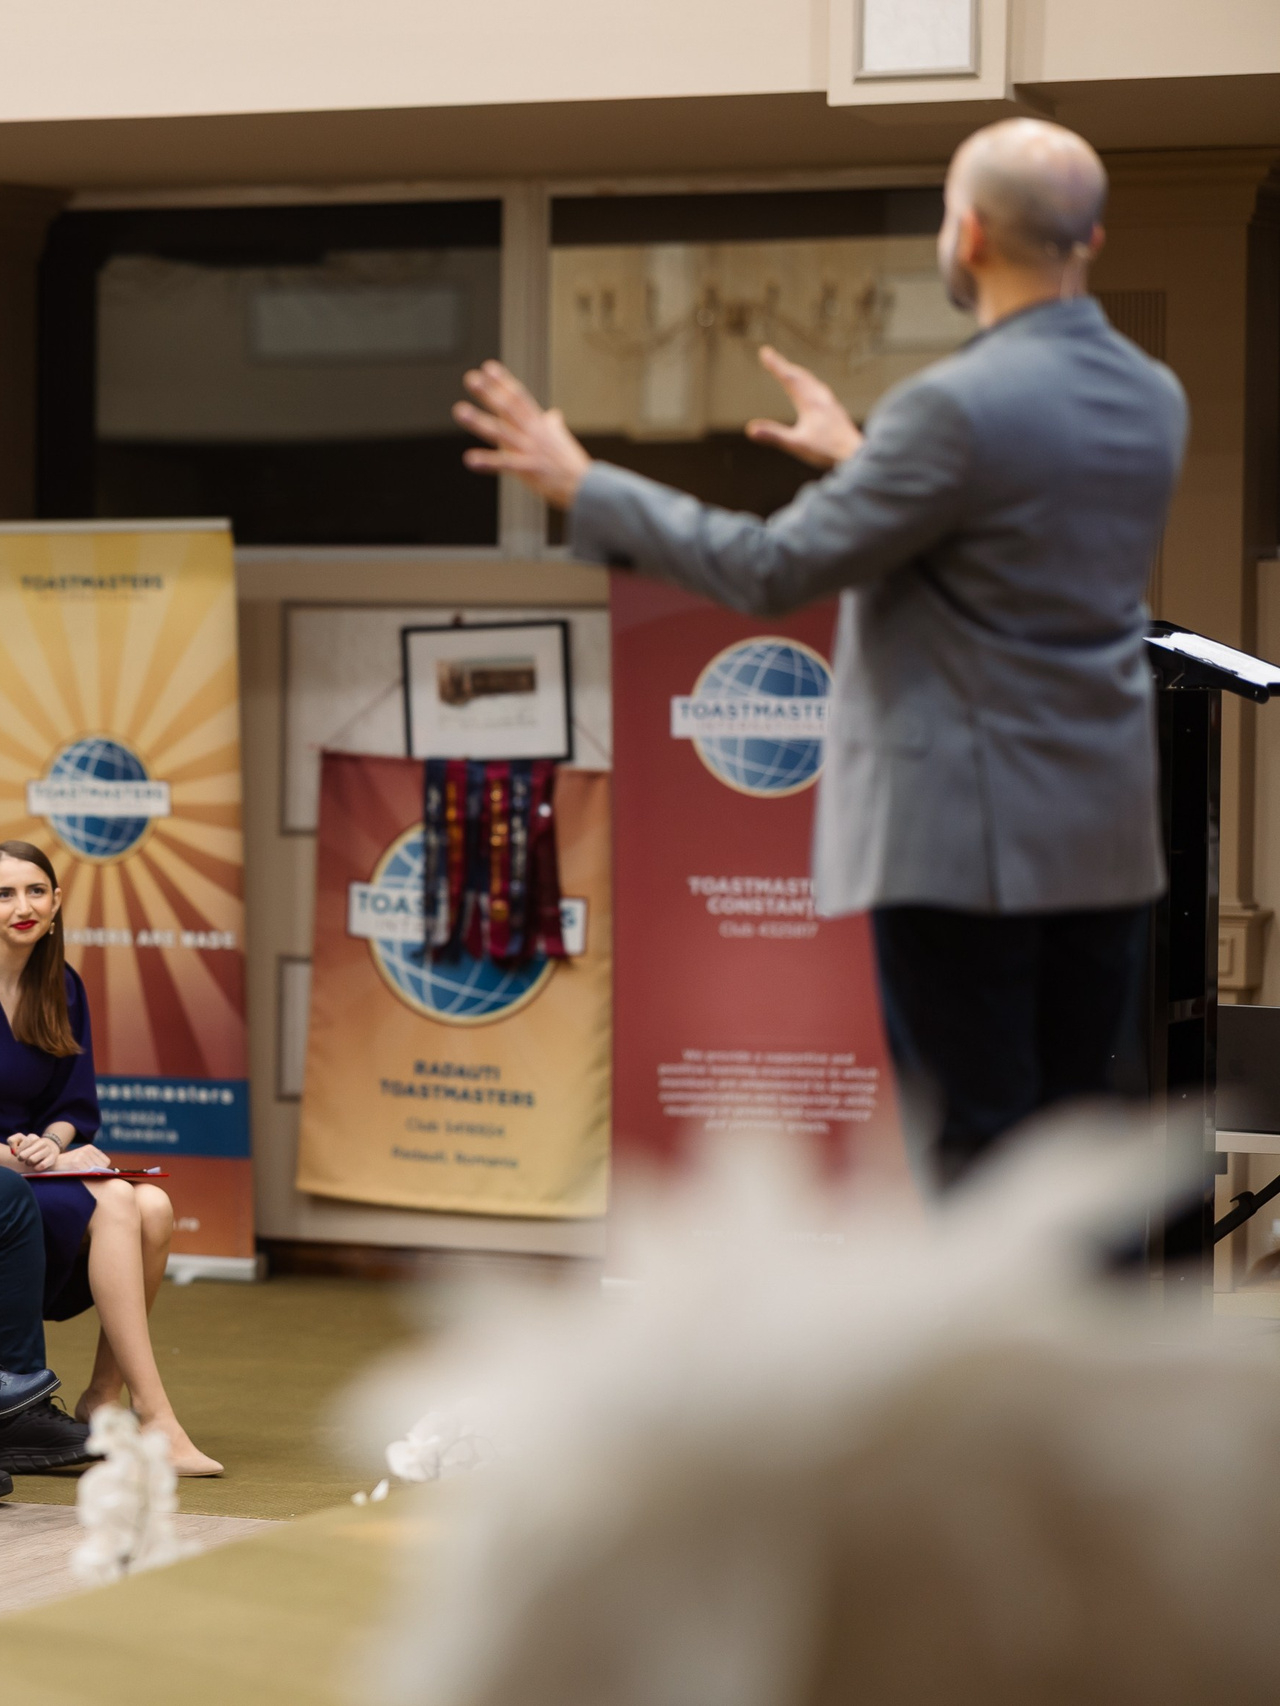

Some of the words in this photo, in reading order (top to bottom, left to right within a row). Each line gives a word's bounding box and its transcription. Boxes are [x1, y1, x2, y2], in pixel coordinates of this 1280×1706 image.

[21, 575, 164, 590] TOASTMASTERS
[681, 703, 825, 719] TOASTMASTE
[34, 786, 163, 800] TOASTMASTERS
[380, 1078, 535, 1108] TOASTMASTERS
